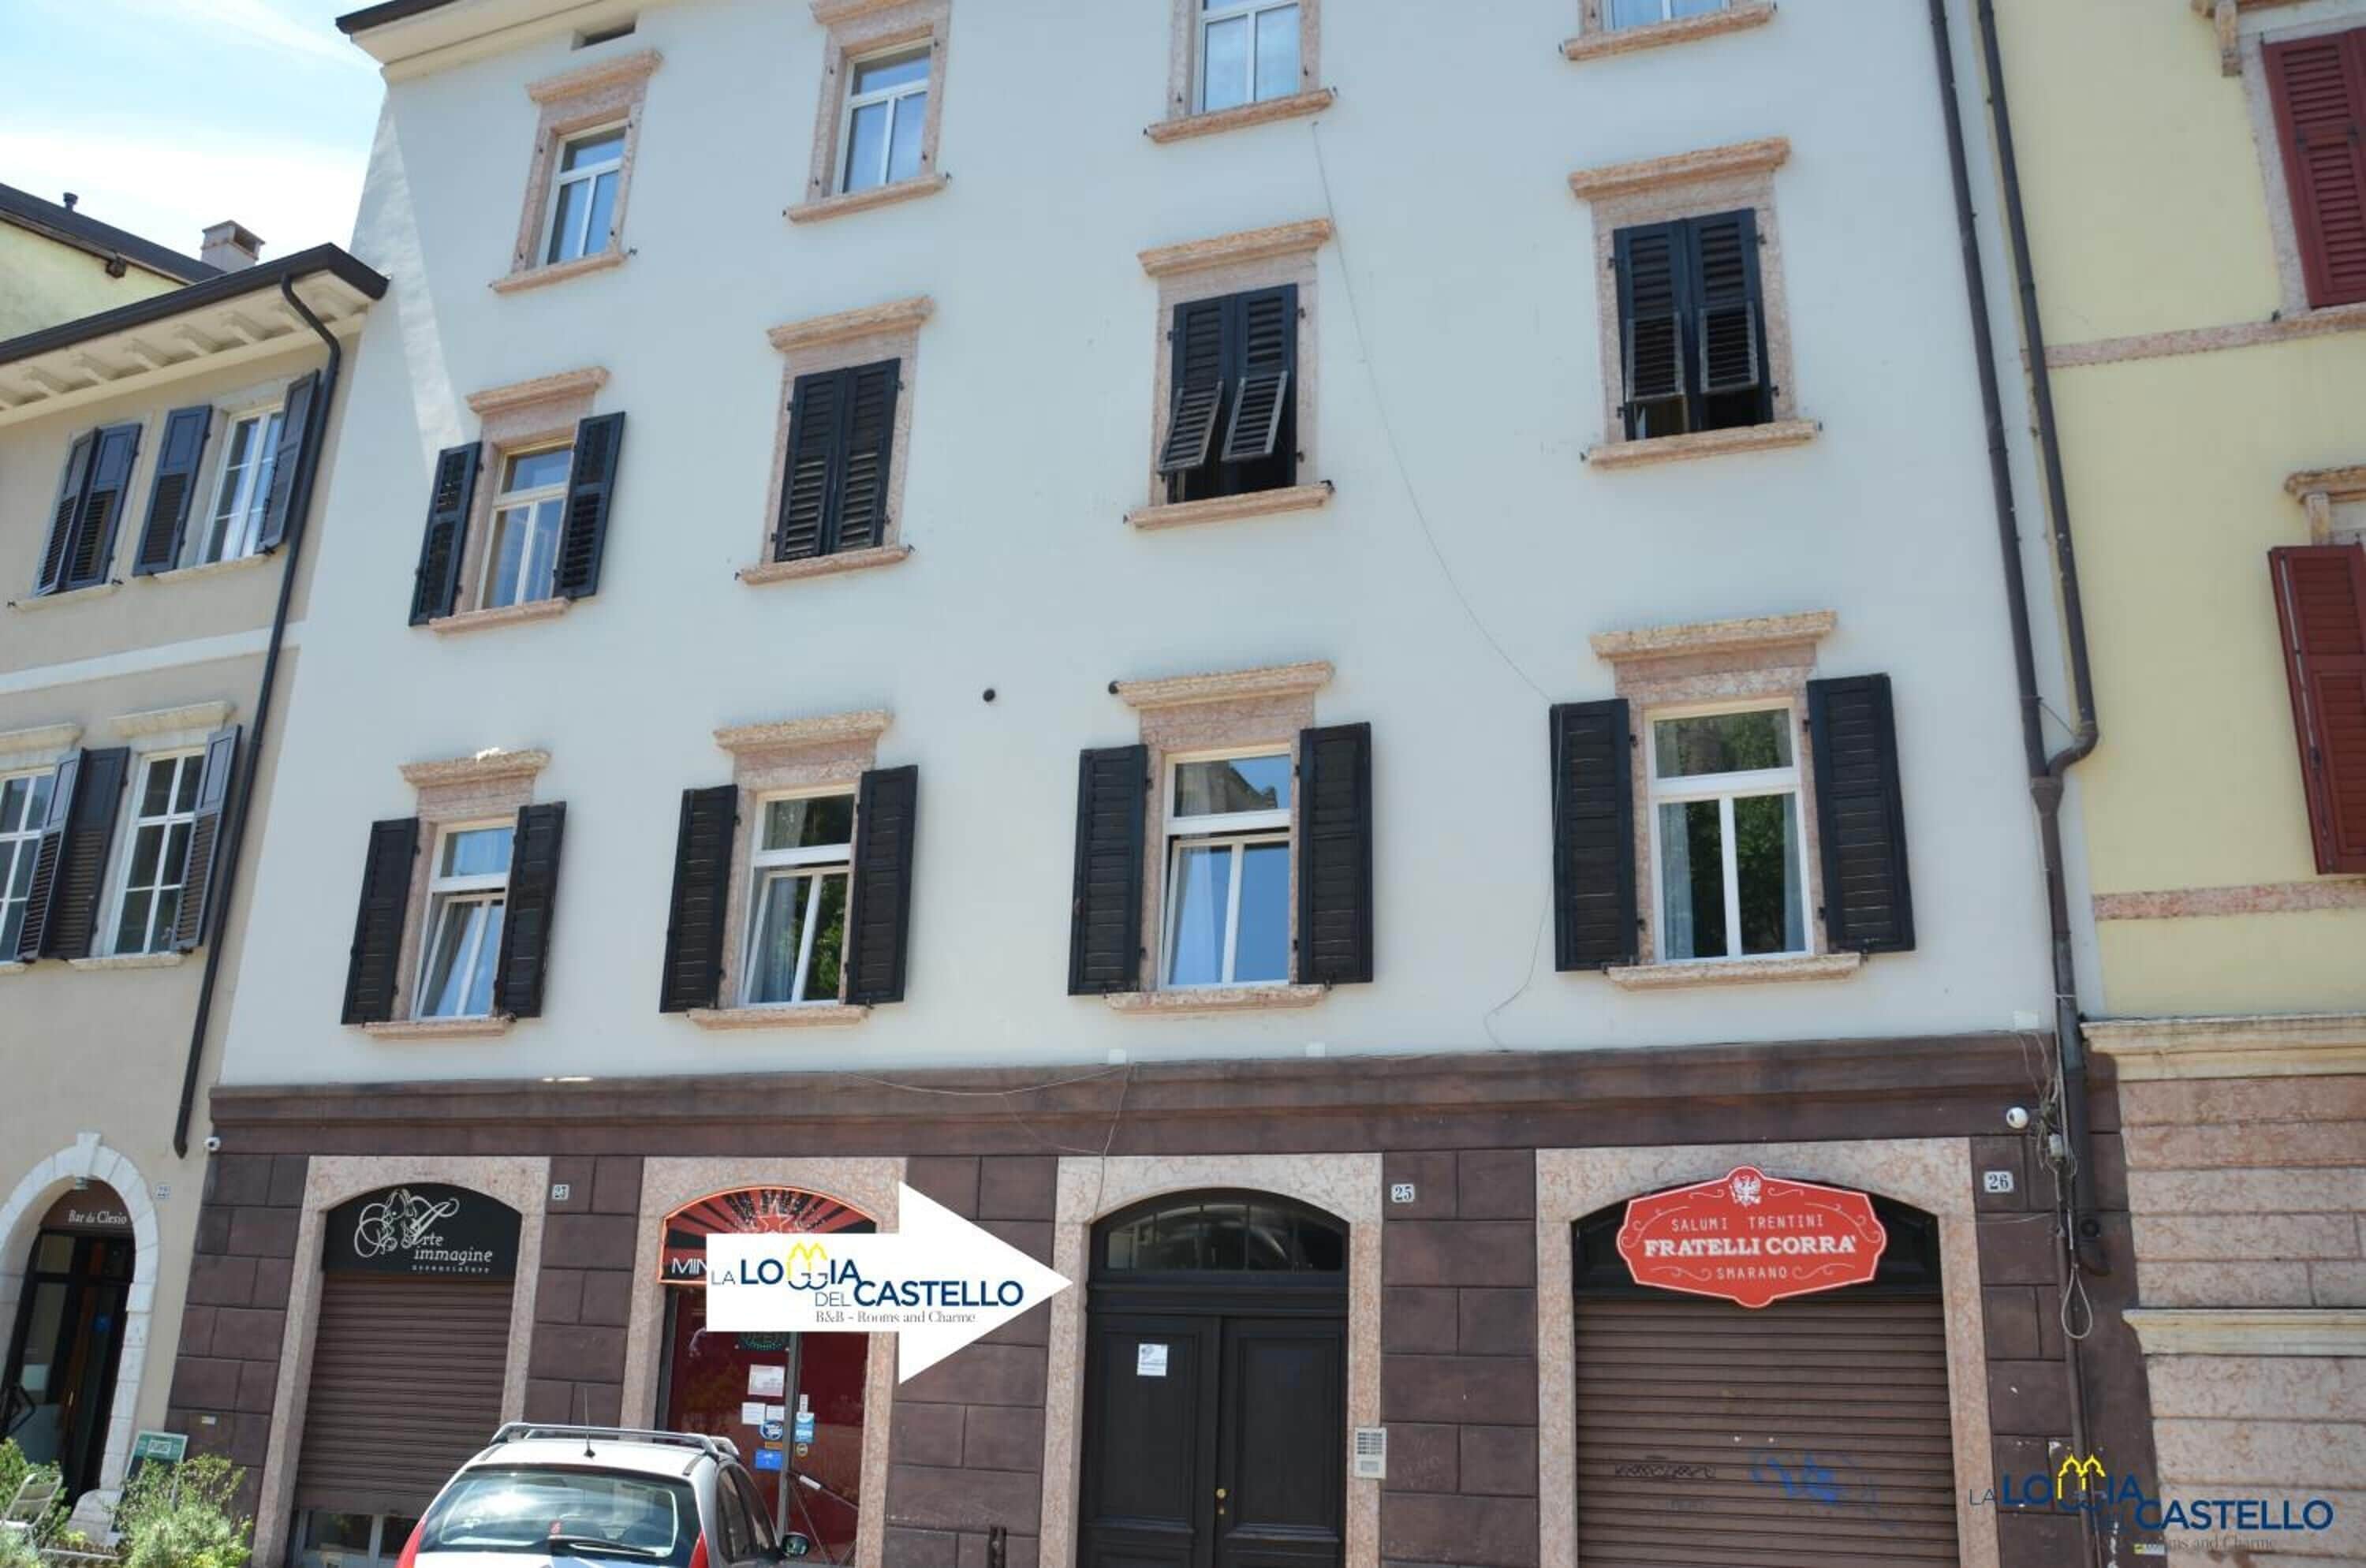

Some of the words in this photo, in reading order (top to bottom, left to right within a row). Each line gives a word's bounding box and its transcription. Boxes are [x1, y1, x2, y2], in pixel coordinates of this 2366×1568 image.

[1988, 1173, 2009, 1189] 26
[1395, 1185, 1412, 1200] 25
[69, 1209, 83, 1223] Bar
[97, 1211, 126, 1224] Clesio
[1671, 1217, 1729, 1232] SALUMI
[1748, 1213, 1824, 1230] TRENTINI
[1644, 1236, 1761, 1257] FRATELLI
[413, 1245, 493, 1265] immagine
[1716, 1265, 1787, 1279] SMARANO
